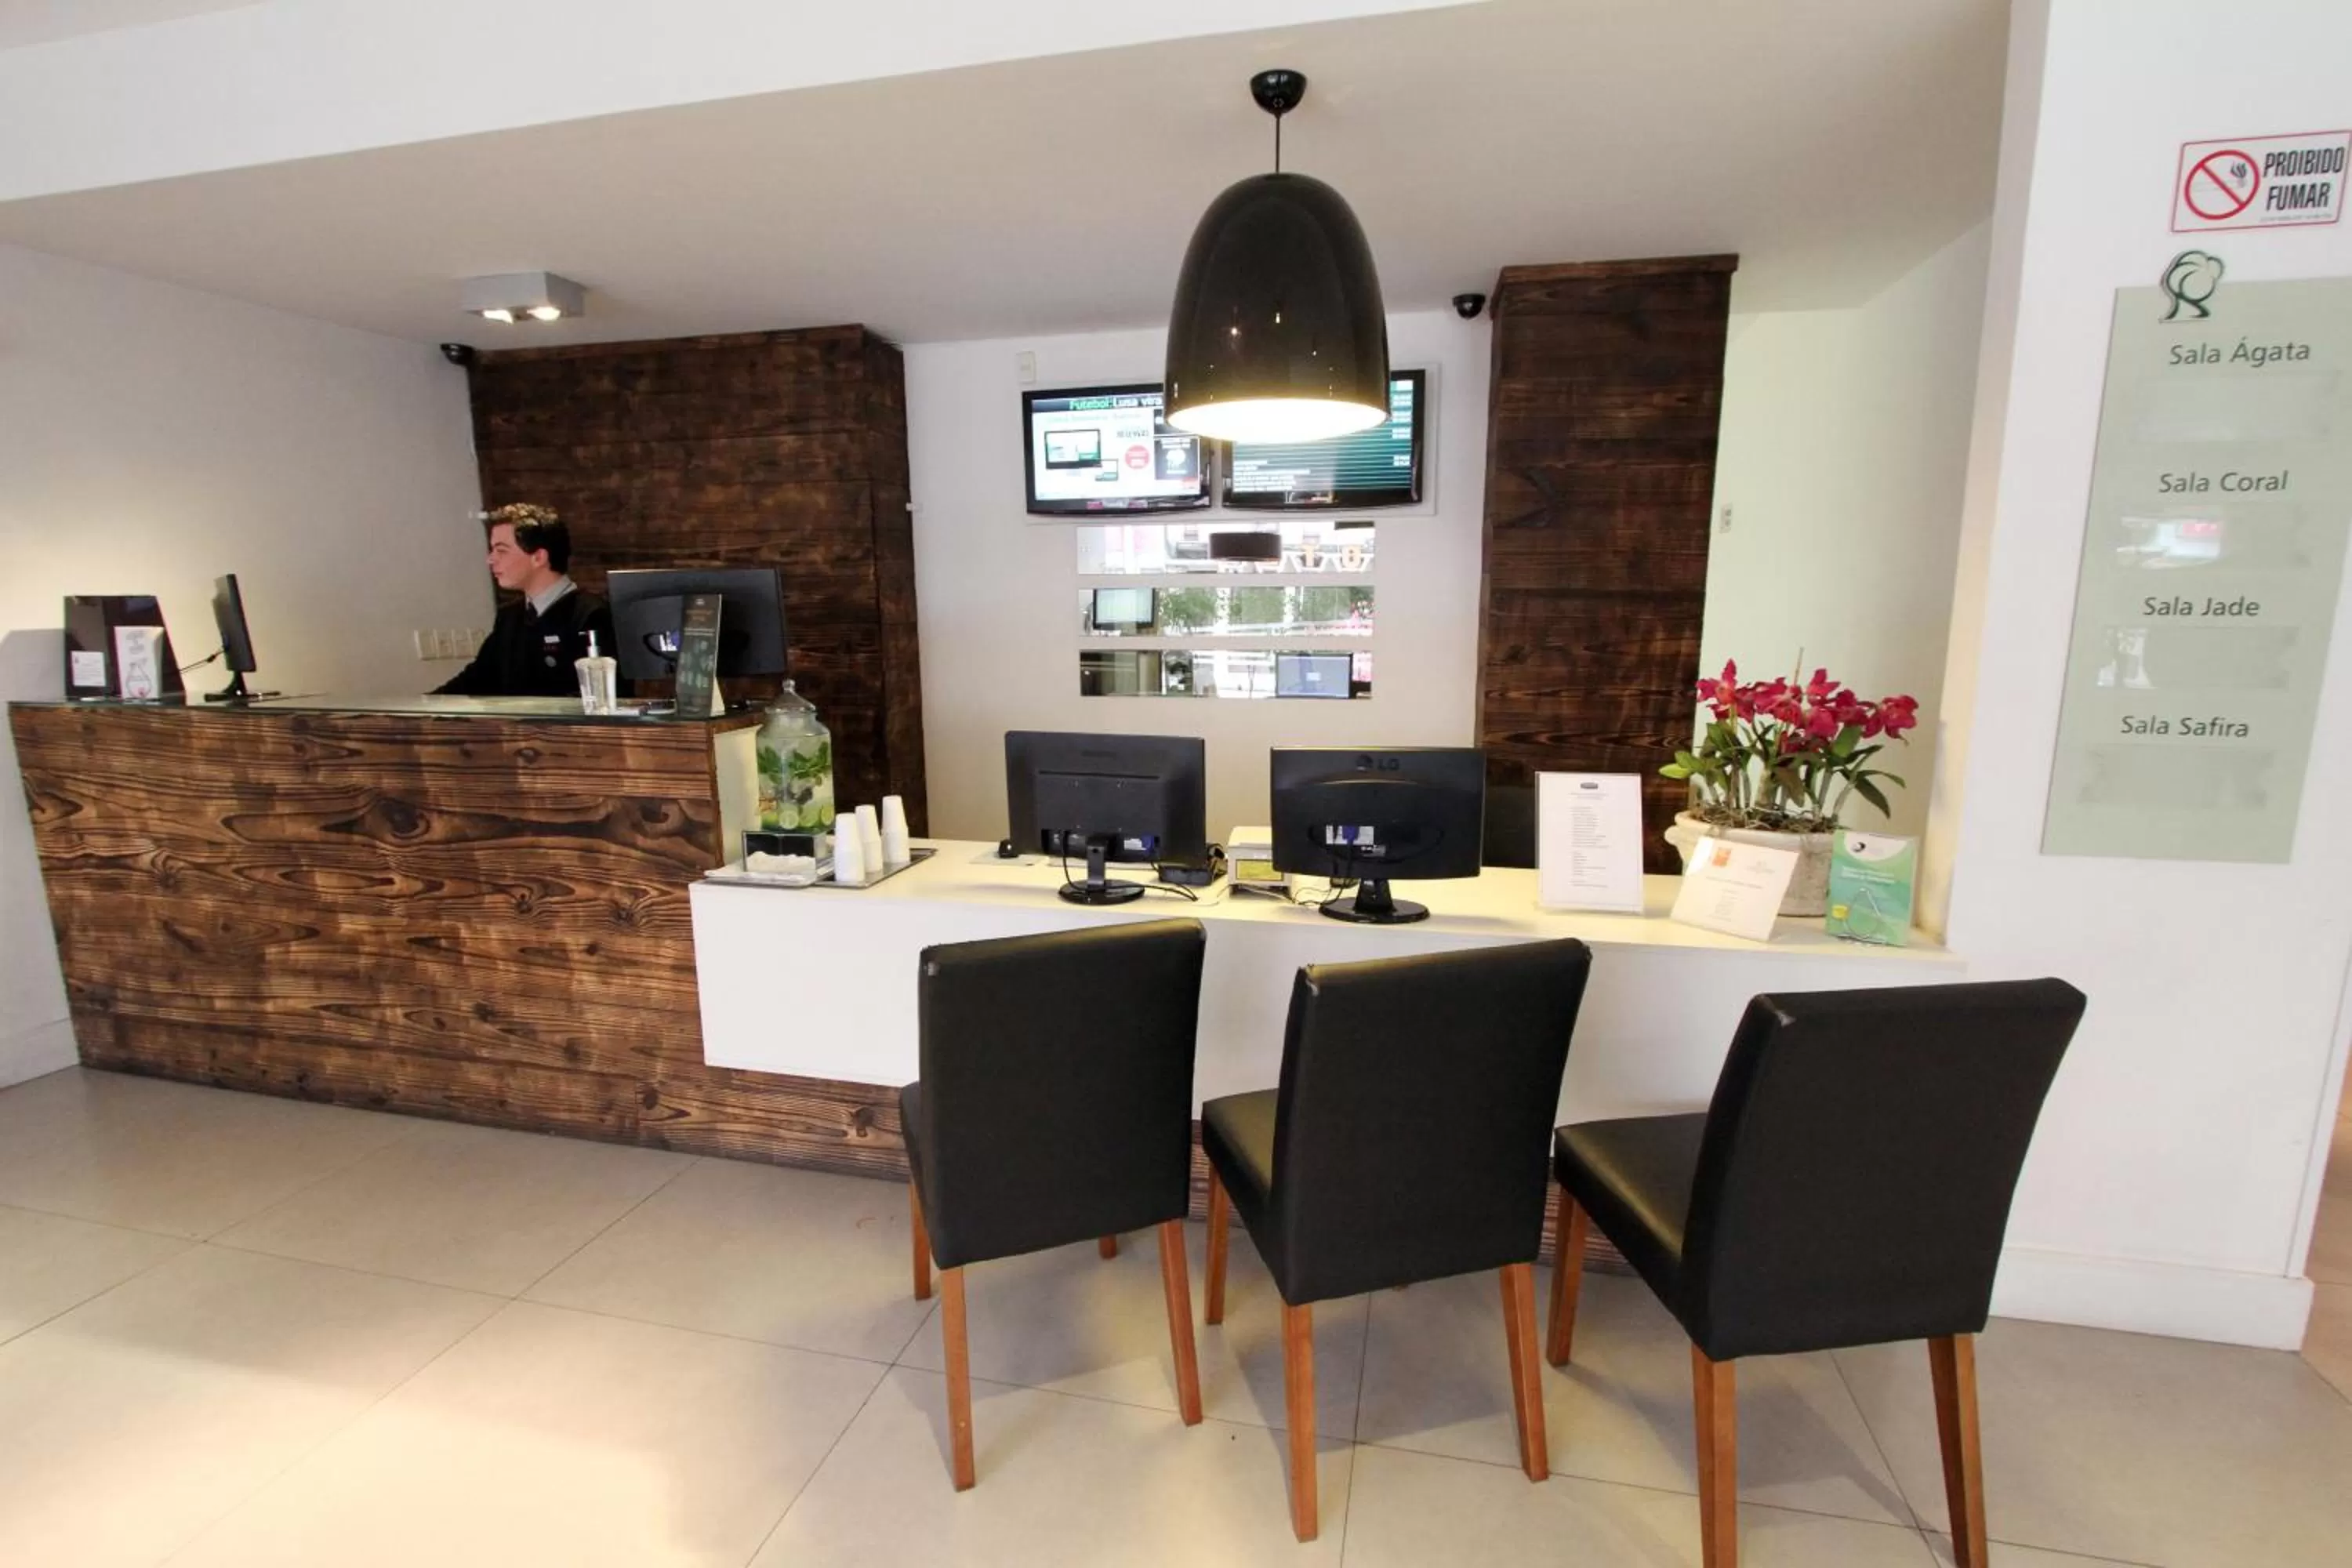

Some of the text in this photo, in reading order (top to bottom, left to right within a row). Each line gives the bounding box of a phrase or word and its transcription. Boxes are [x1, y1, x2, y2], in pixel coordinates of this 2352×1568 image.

[2263, 147, 2345, 178] PROIBIDO
[2267, 182, 2331, 211] FUMAR
[2169, 336, 2310, 368] Sala Ágata
[2158, 470, 2288, 493] Sala Coral
[2143, 595, 2260, 616] Sala Jade
[2121, 714, 2249, 738] Sala Safira
[1377, 757, 1400, 771] LG
